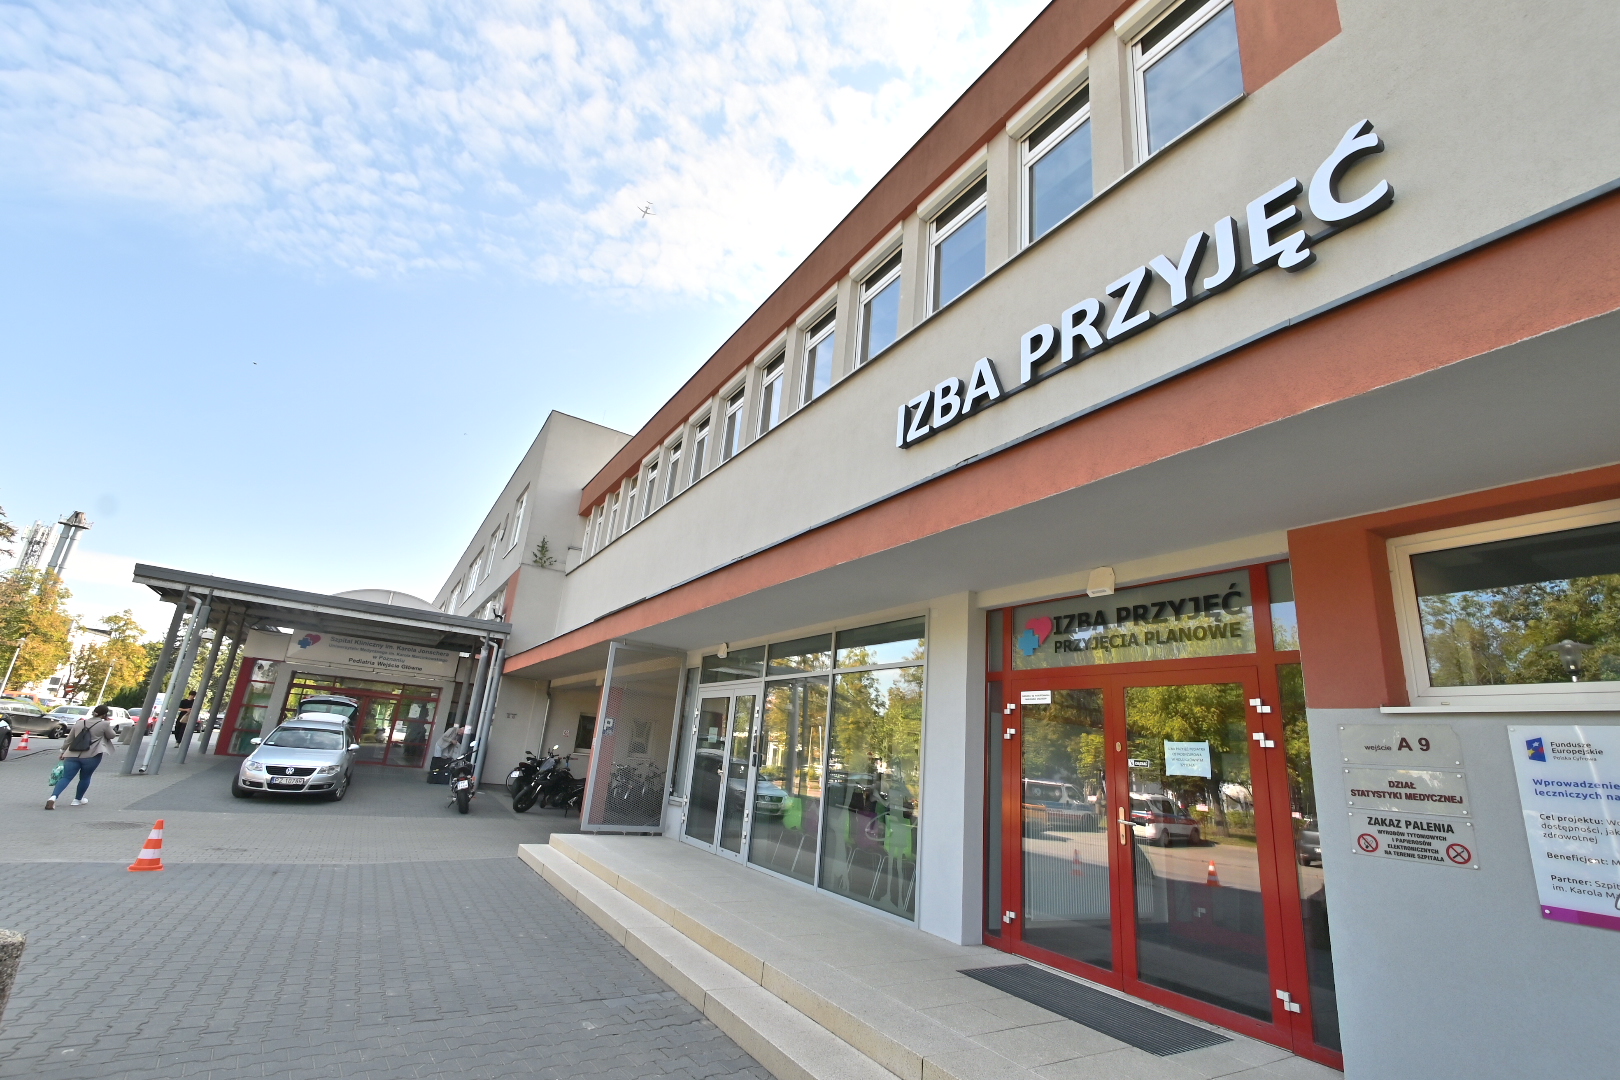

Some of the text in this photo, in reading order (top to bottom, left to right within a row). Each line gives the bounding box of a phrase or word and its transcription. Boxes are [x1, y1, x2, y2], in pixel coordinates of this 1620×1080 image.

[896, 118, 1395, 448] IZBA PRZYJĘĆ
[1053, 582, 1242, 635] IZBA PRZYJĘĆ
[1054, 621, 1242, 654] PRZYJĘCIA PLANOWE
[330, 636, 352, 644] Szpital
[354, 639, 384, 649] Kliniczny
[396, 645, 417, 653] Karola
[348, 657, 375, 666] Pediatria
[377, 660, 400, 669] Wejście
[1364, 737, 1431, 752] wejście A 9
[1551, 747, 1604, 755] Europejskie
[1388, 780, 1417, 790] DZIAŁ
[1532, 778, 1620, 790] Wprowadzenie
[1350, 788, 1464, 804] STATYSTYKI MEDYCZNEJ
[1534, 788, 1602, 801] leczniczych
[1367, 816, 1455, 834] ZAKAZ PALENIA
[1539, 813, 1555, 821] Cel
[1557, 815, 1604, 825] projektu:
[1541, 822, 1603, 835] dostępności,
[1377, 829, 1447, 842] WYROBÓW TYTONIOWYCH
[1395, 837, 1432, 847] PAPIEROSÓW
[1543, 832, 1598, 845] zdrowotnej
[1387, 843, 1440, 855] ELEKTRONICZNYCH
[1393, 850, 1416, 859] TERENIE
[1417, 853, 1445, 862] SZPITALA
[1546, 851, 1609, 866] Beneficjent:
[1550, 874, 1593, 887] Partner:
[1552, 883, 1567, 893] im.
[1570, 886, 1603, 898] Karola
